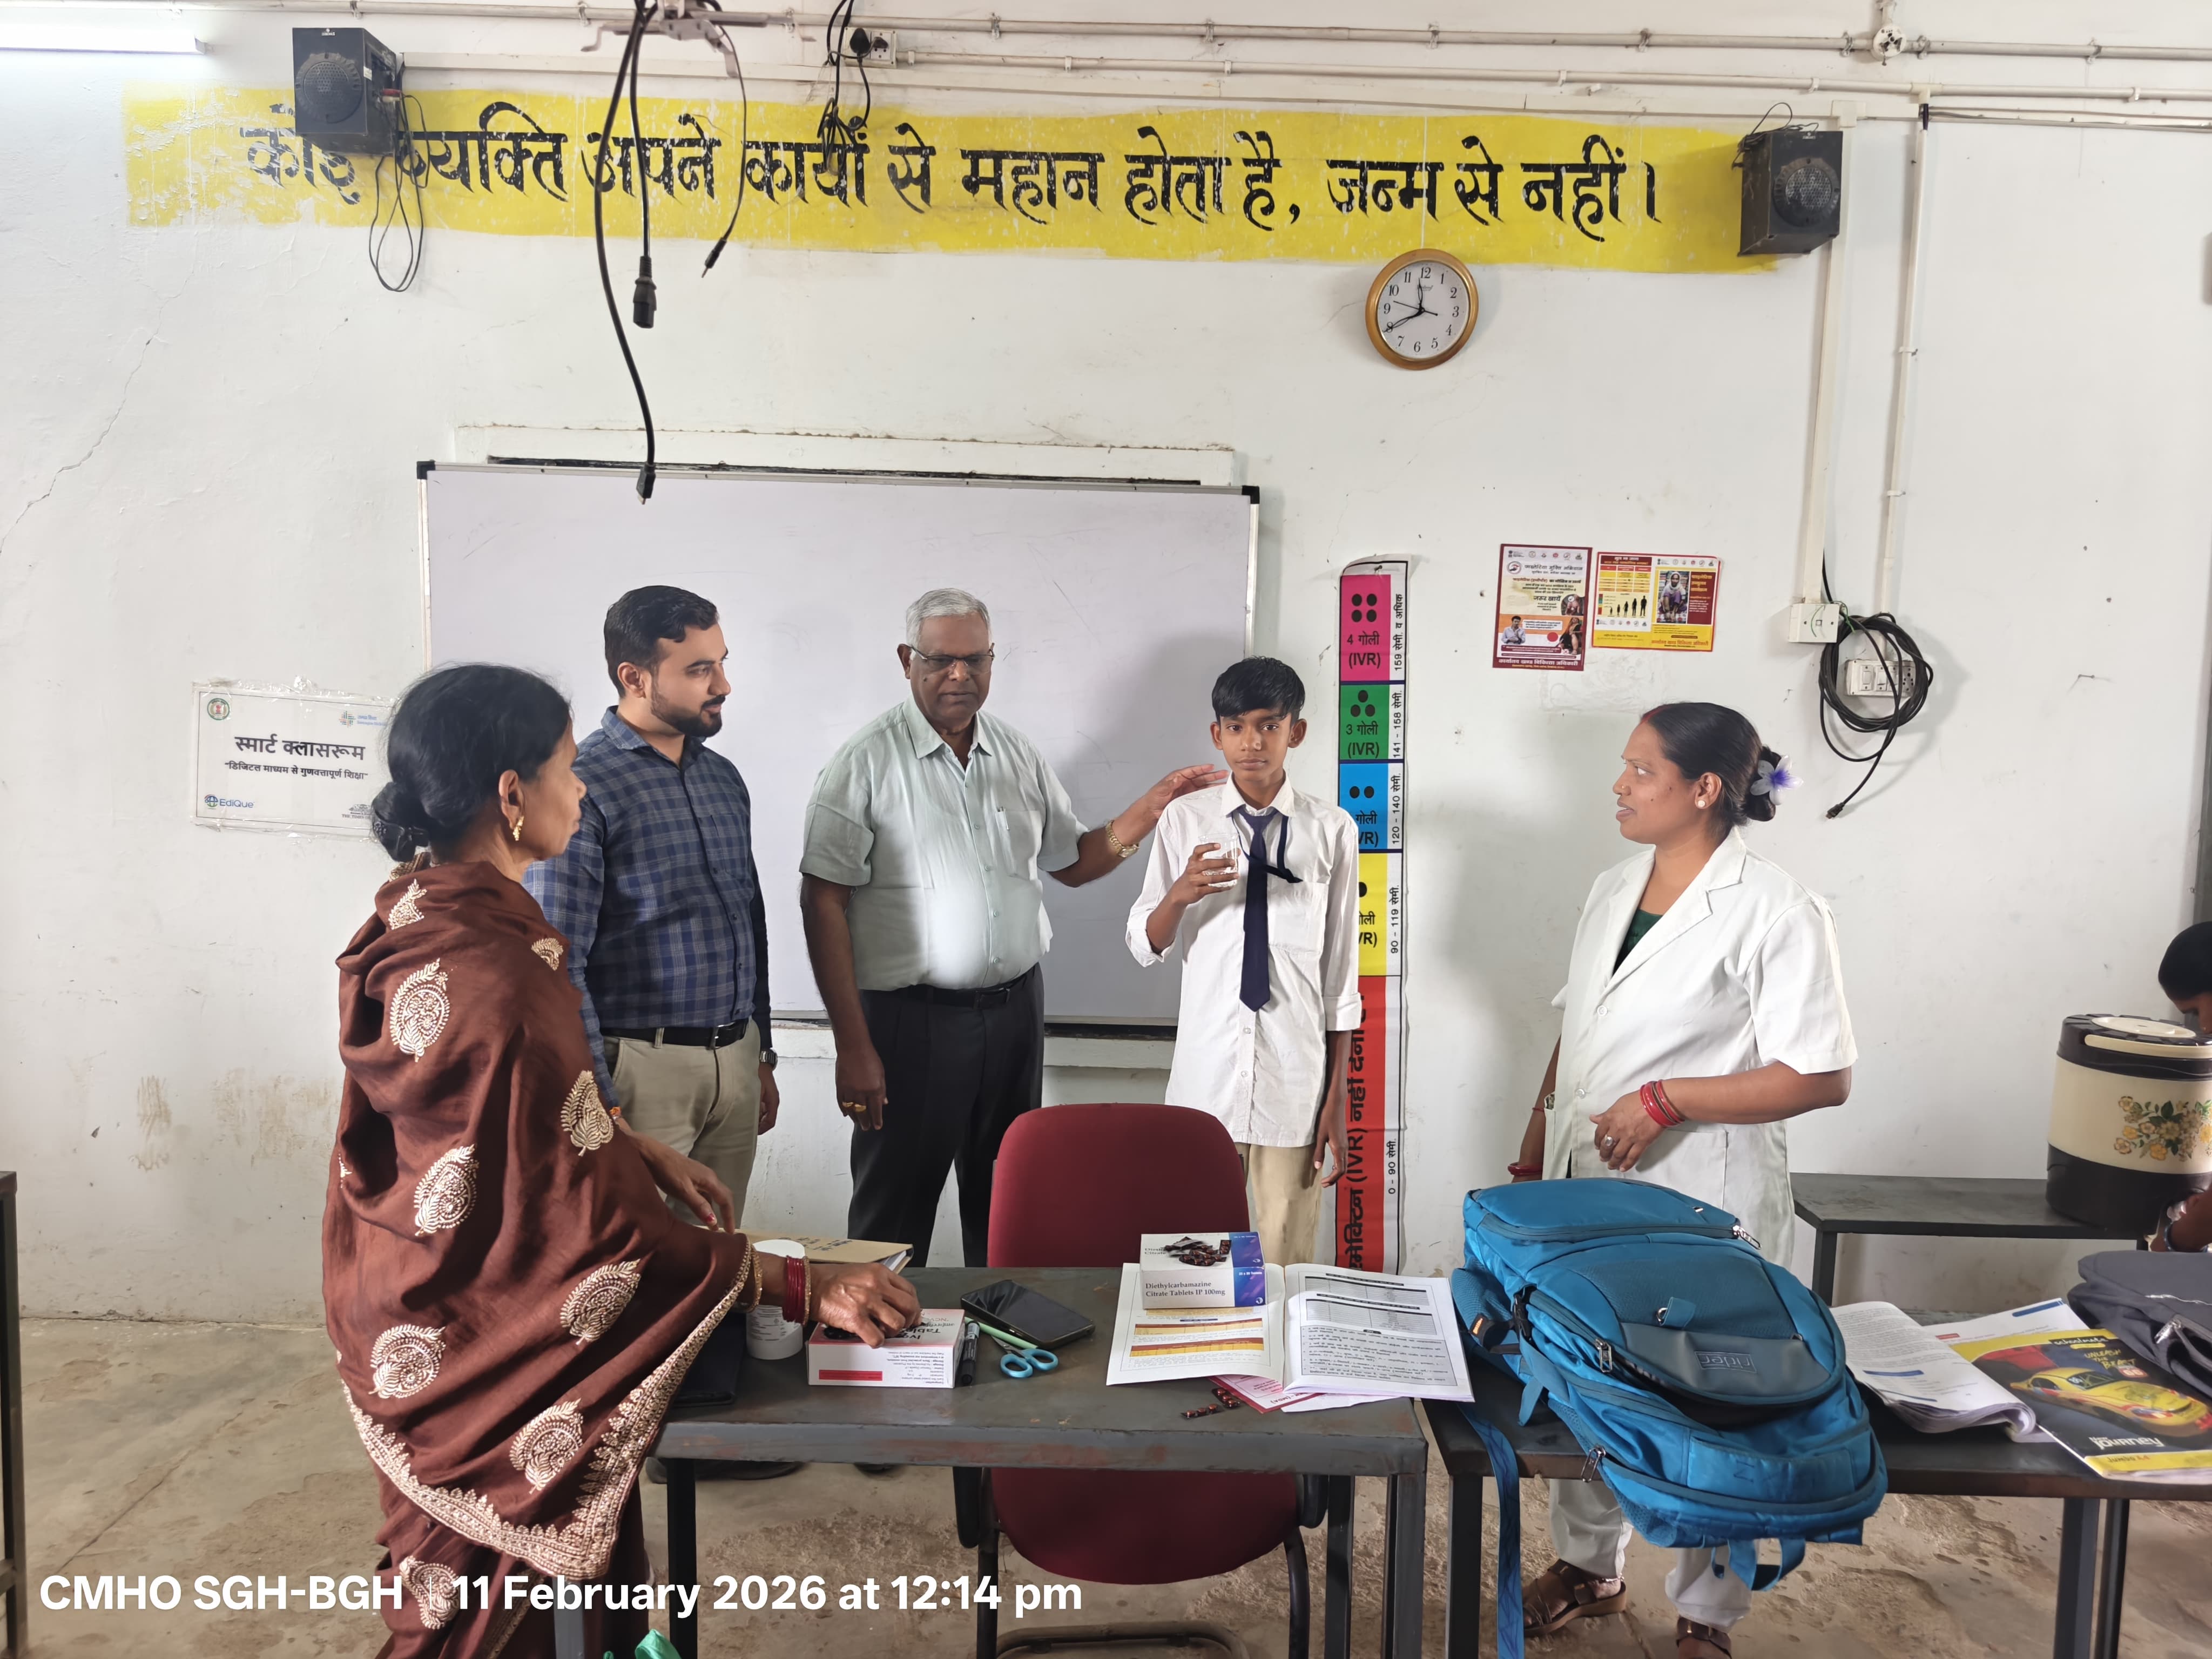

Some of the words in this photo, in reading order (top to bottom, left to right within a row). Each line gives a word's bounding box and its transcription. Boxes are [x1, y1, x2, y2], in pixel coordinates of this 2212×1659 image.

[395, 102, 568, 202] व्यक्ति
[581, 113, 722, 202] अपने
[887, 123, 936, 213] से
[960, 149, 1105, 225] महान
[1124, 126, 1232, 225] होता
[1233, 131, 1300, 231] है,
[1326, 160, 1444, 222] जन्म
[1454, 136, 1504, 226] से
[1404, 271, 1411, 283] 11
[1420, 267, 1431, 278] 12
[1440, 273, 1444, 284] 1
[1389, 285, 1399, 296] 10
[1450, 287, 1457, 298] 2
[1384, 303, 1391, 314] 9
[1452, 306, 1459, 317] 3
[1386, 322, 1393, 333] 8
[1446, 324, 1452, 335] 4
[1397, 336, 1405, 347] 7
[1414, 341, 1420, 352] 6
[1431, 338, 1438, 348] 5
[1393, 594, 1402, 619] अधिक
[1347, 634, 1353, 645] 4
[1358, 631, 1379, 645] गोली
[1393, 632, 1403, 651] सेमी.
[1348, 652, 1381, 669] (IVR)
[1392, 690, 1402, 709] सेमी.
[1346, 724, 1353, 735] 3
[1357, 721, 1378, 735] गोली
[234, 733, 278, 754] स्मार्ट
[282, 740, 366, 760] क्लासरूम
[1348, 742, 1379, 759] (IVR)
[263, 765, 288, 774] माध्यम
[291, 765, 298, 774] से
[300, 767, 343, 779] गुणवत्तापूर्ण
[1391, 773, 1401, 792] सेमी.
[219, 799, 254, 808] EdiQue
[1355, 810, 1378, 824] गोली
[1358, 831, 1379, 847] VR)
[1389, 885, 1399, 905] सेमी.
[1391, 941, 1398, 954] 90
[1347, 1128, 1367, 1183] (IVR)
[1388, 1162, 1395, 1175] 90
[1145, 1281, 1211, 1290] Diethylcarbamazine
[1700, 1355, 1750, 1369] rider
